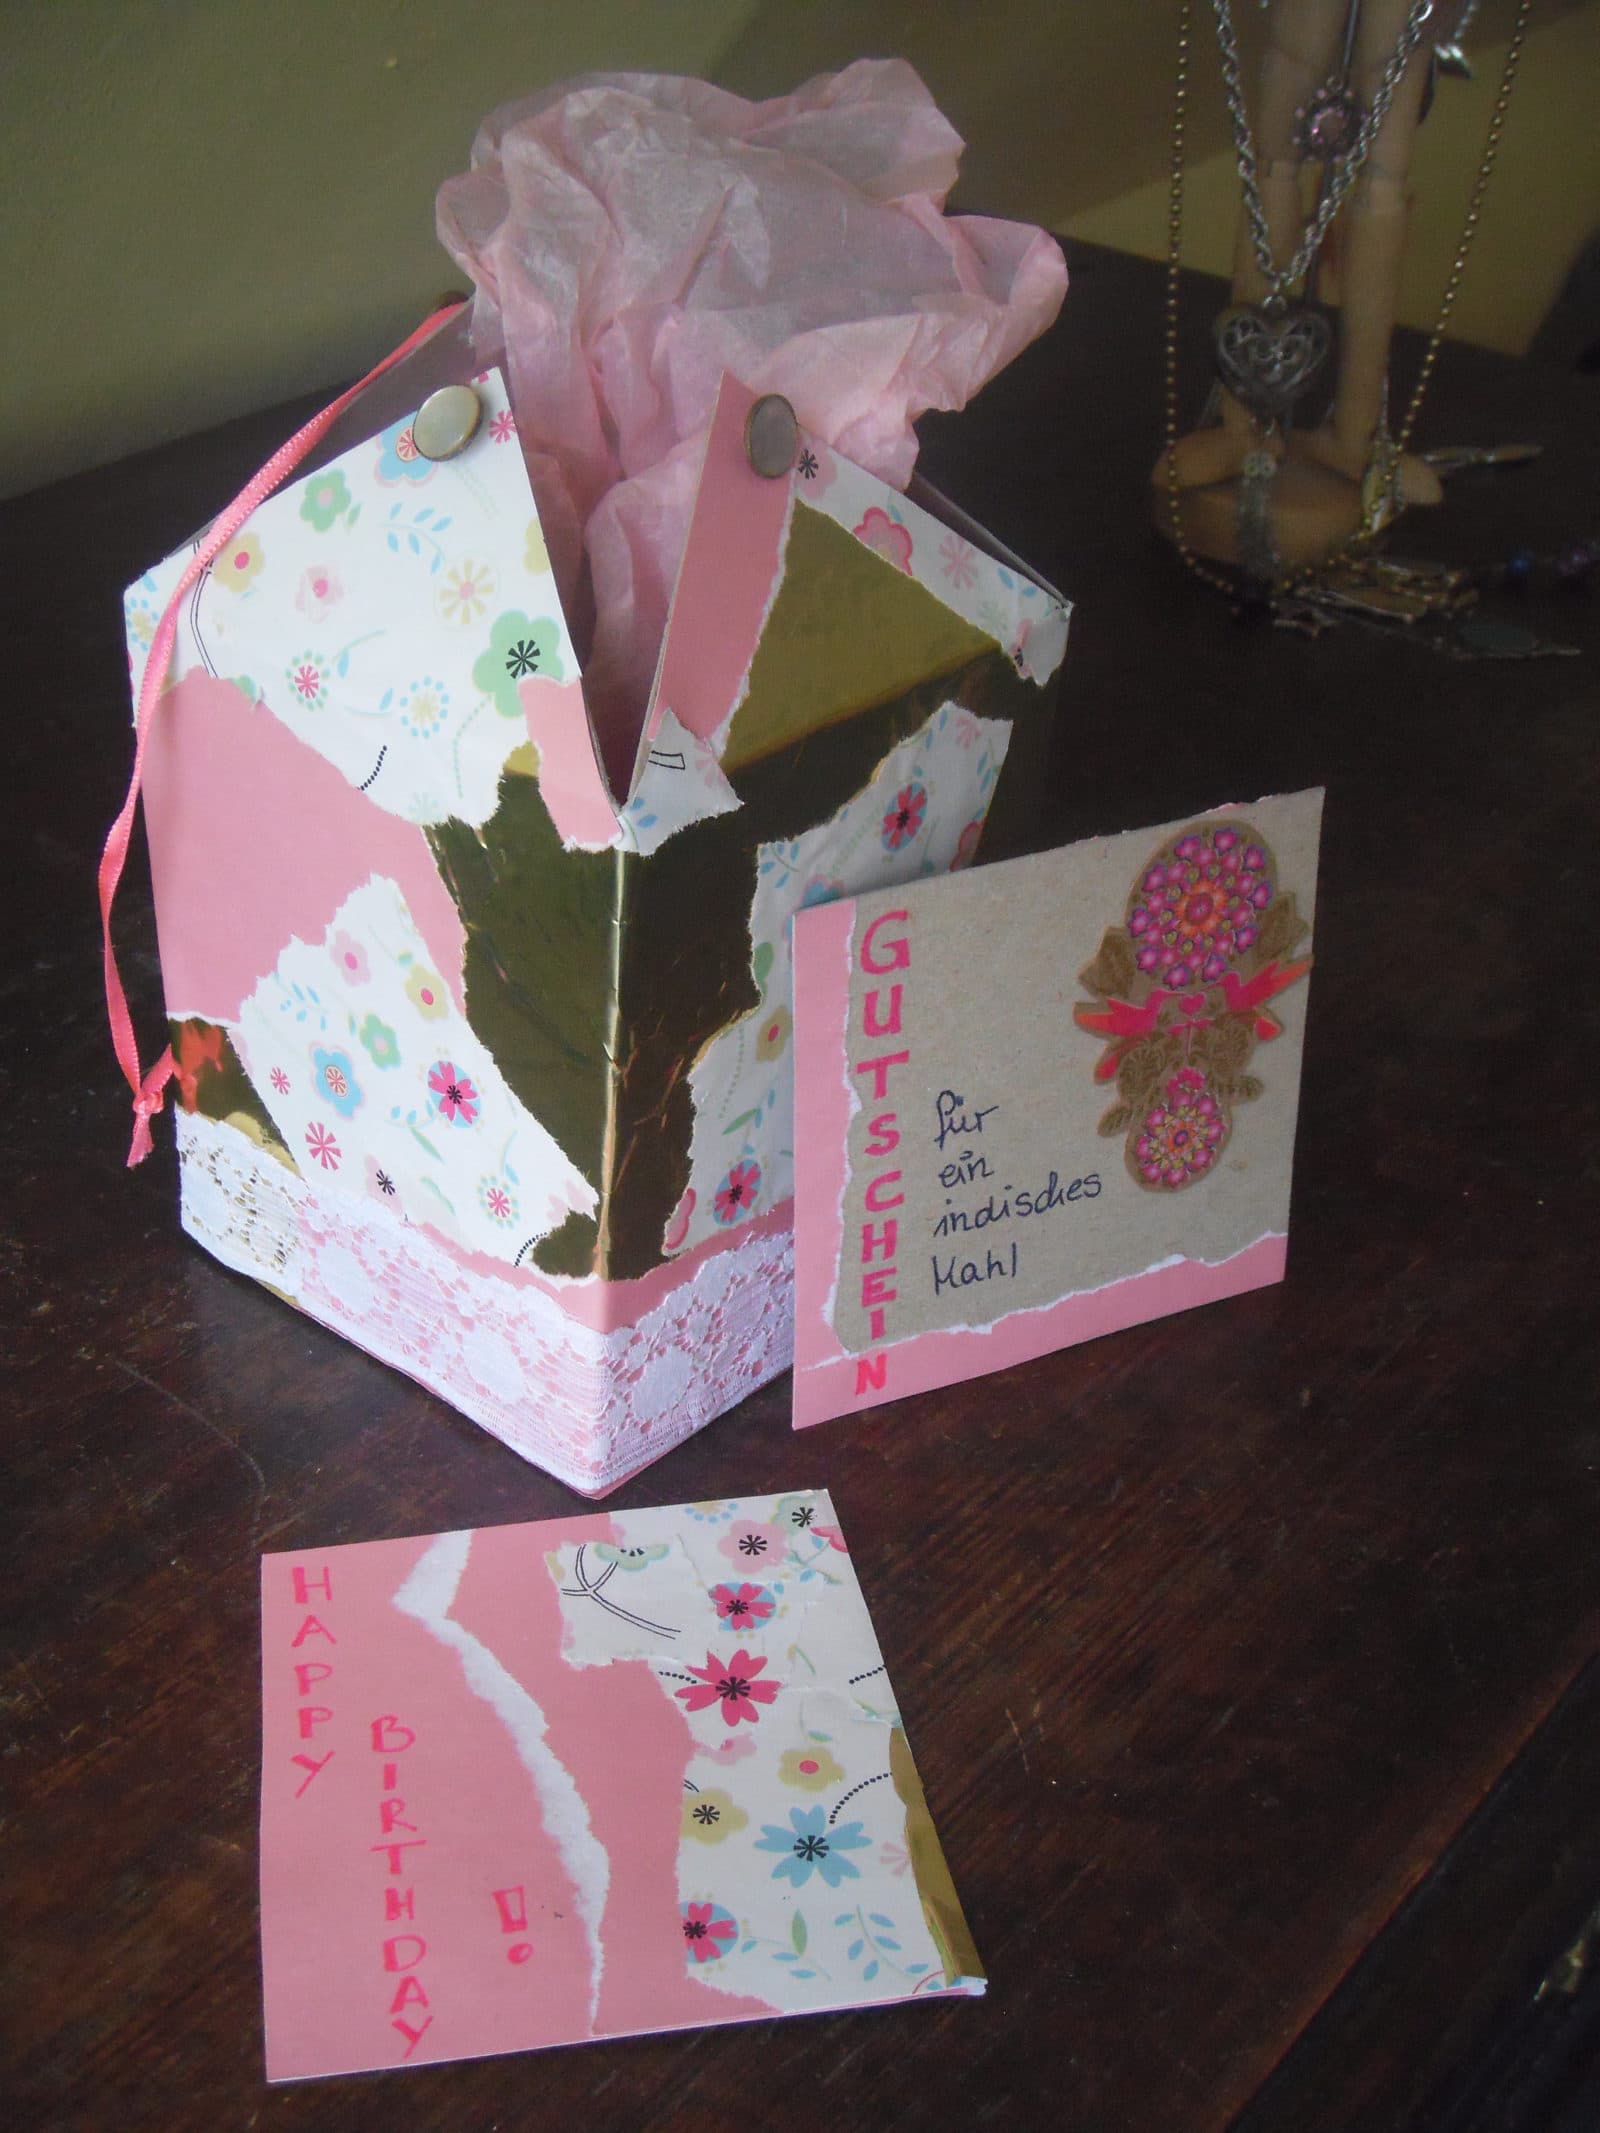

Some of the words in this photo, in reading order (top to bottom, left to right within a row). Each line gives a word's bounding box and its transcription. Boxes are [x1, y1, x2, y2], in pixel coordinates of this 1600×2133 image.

[854, 909, 912, 1395] GUTSCHEIN
[933, 1089, 999, 1150] für
[938, 1150, 995, 1188] ein
[933, 1170, 1102, 1238] indisches
[290, 1566, 337, 1799] HAPPY
[370, 1714, 434, 2058] BIRTHDAY
